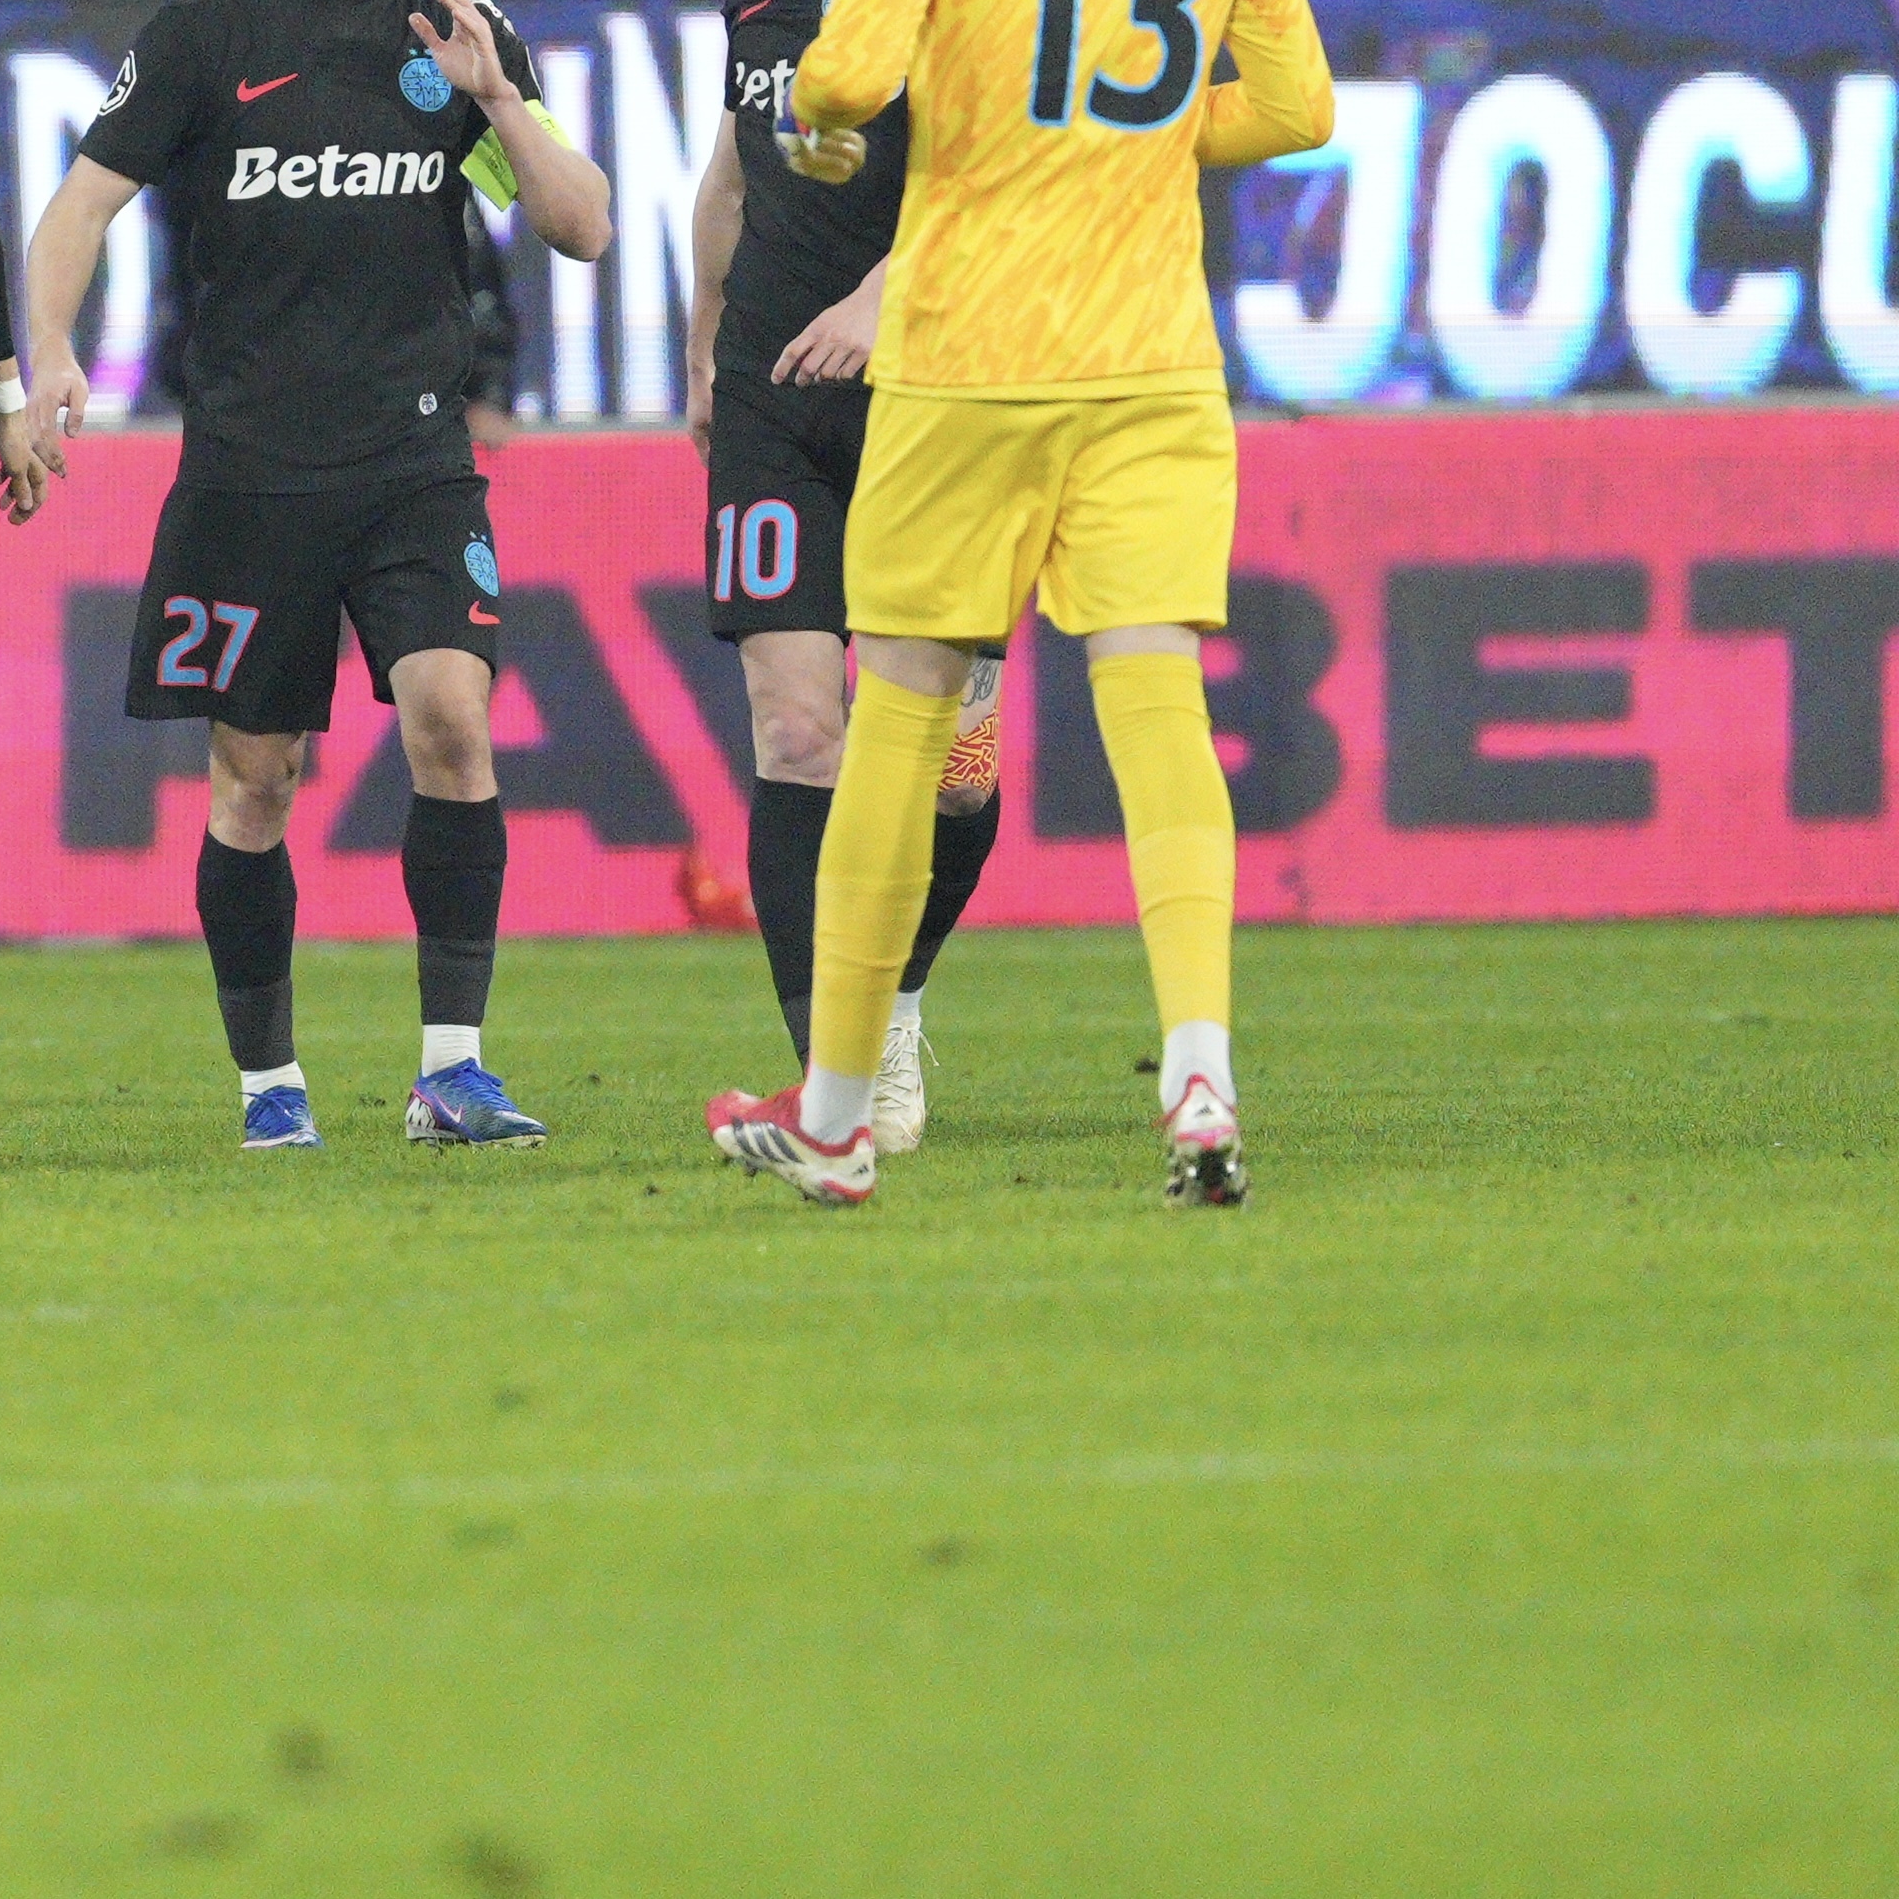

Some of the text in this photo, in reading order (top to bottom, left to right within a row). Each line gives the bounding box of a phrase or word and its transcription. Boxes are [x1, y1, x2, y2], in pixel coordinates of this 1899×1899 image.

[227, 144, 444, 200] Betano
[714, 498, 798, 602] 10
[156, 595, 261, 693] 27
